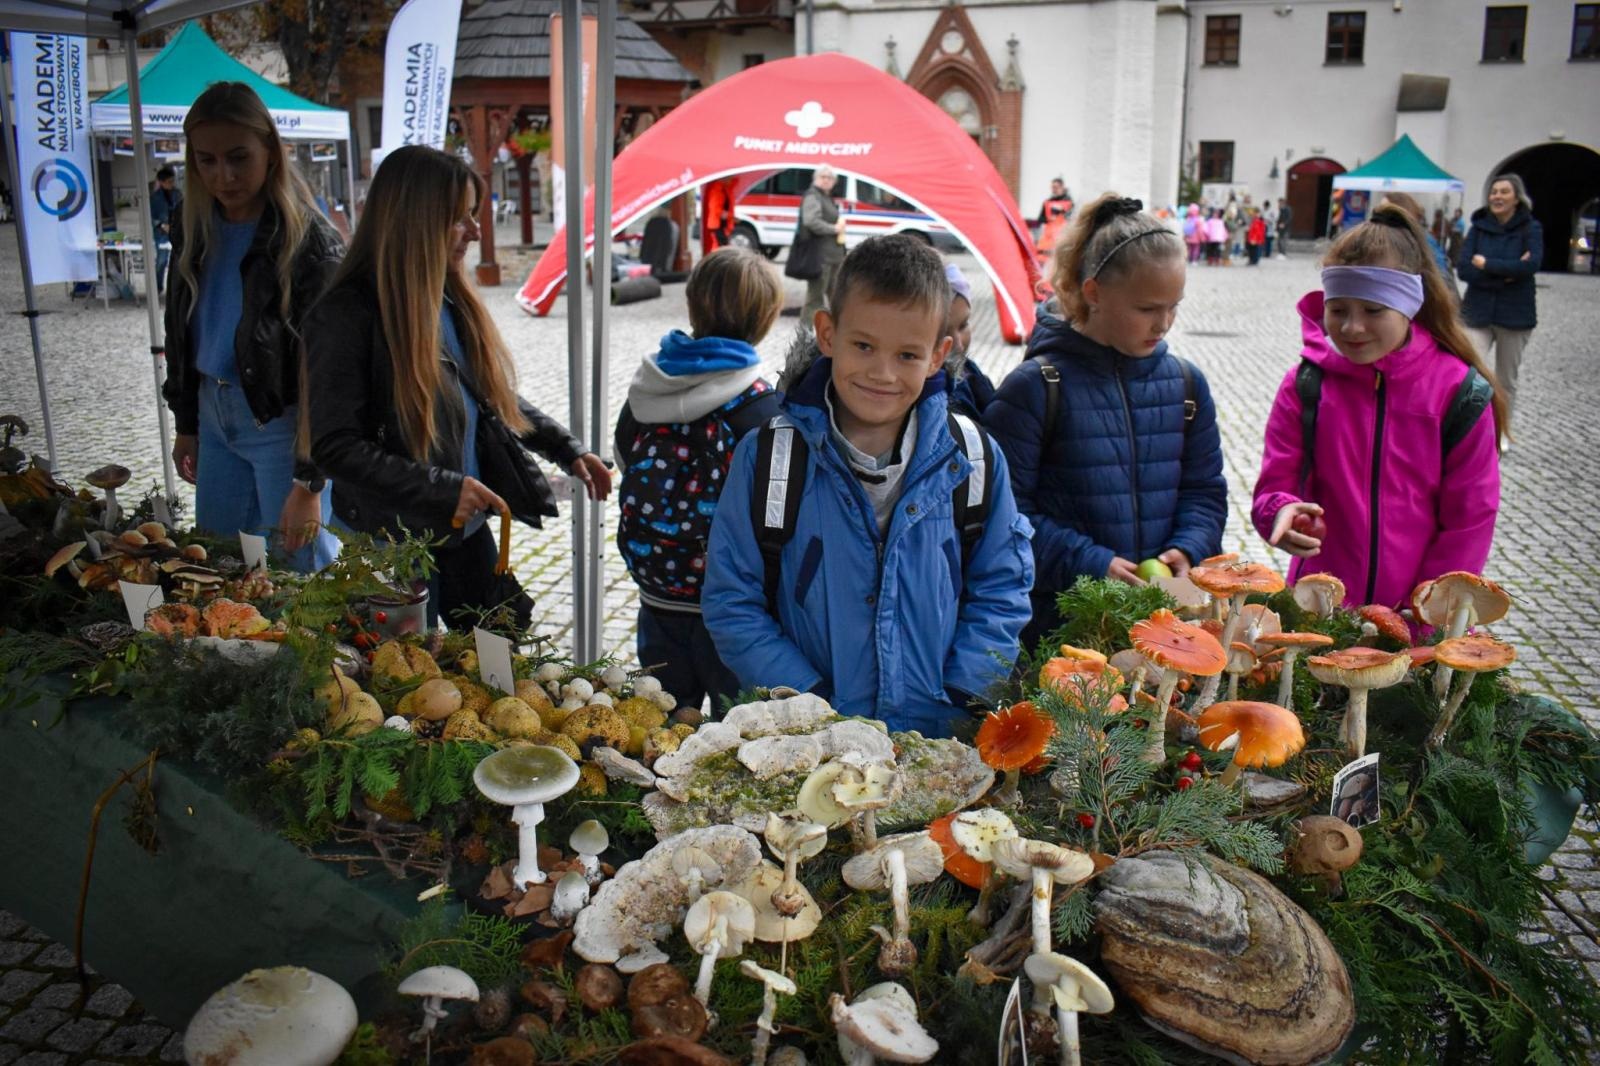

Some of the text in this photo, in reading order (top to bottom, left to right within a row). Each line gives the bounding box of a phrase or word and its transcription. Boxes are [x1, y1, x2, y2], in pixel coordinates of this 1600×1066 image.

[36, 34, 56, 151] AKADEMI
[56, 34, 69, 152] NAUK STOSOWANY
[70, 44, 84, 130] W RACIBORZU
[274, 115, 301, 128] ki.pl
[403, 43, 422, 146] KADEMIA
[418, 43, 434, 129] STOSOWANYCH
[433, 66, 447, 130] RACIBORZU
[733, 135, 873, 156] PUNKT MEDYCZNY
